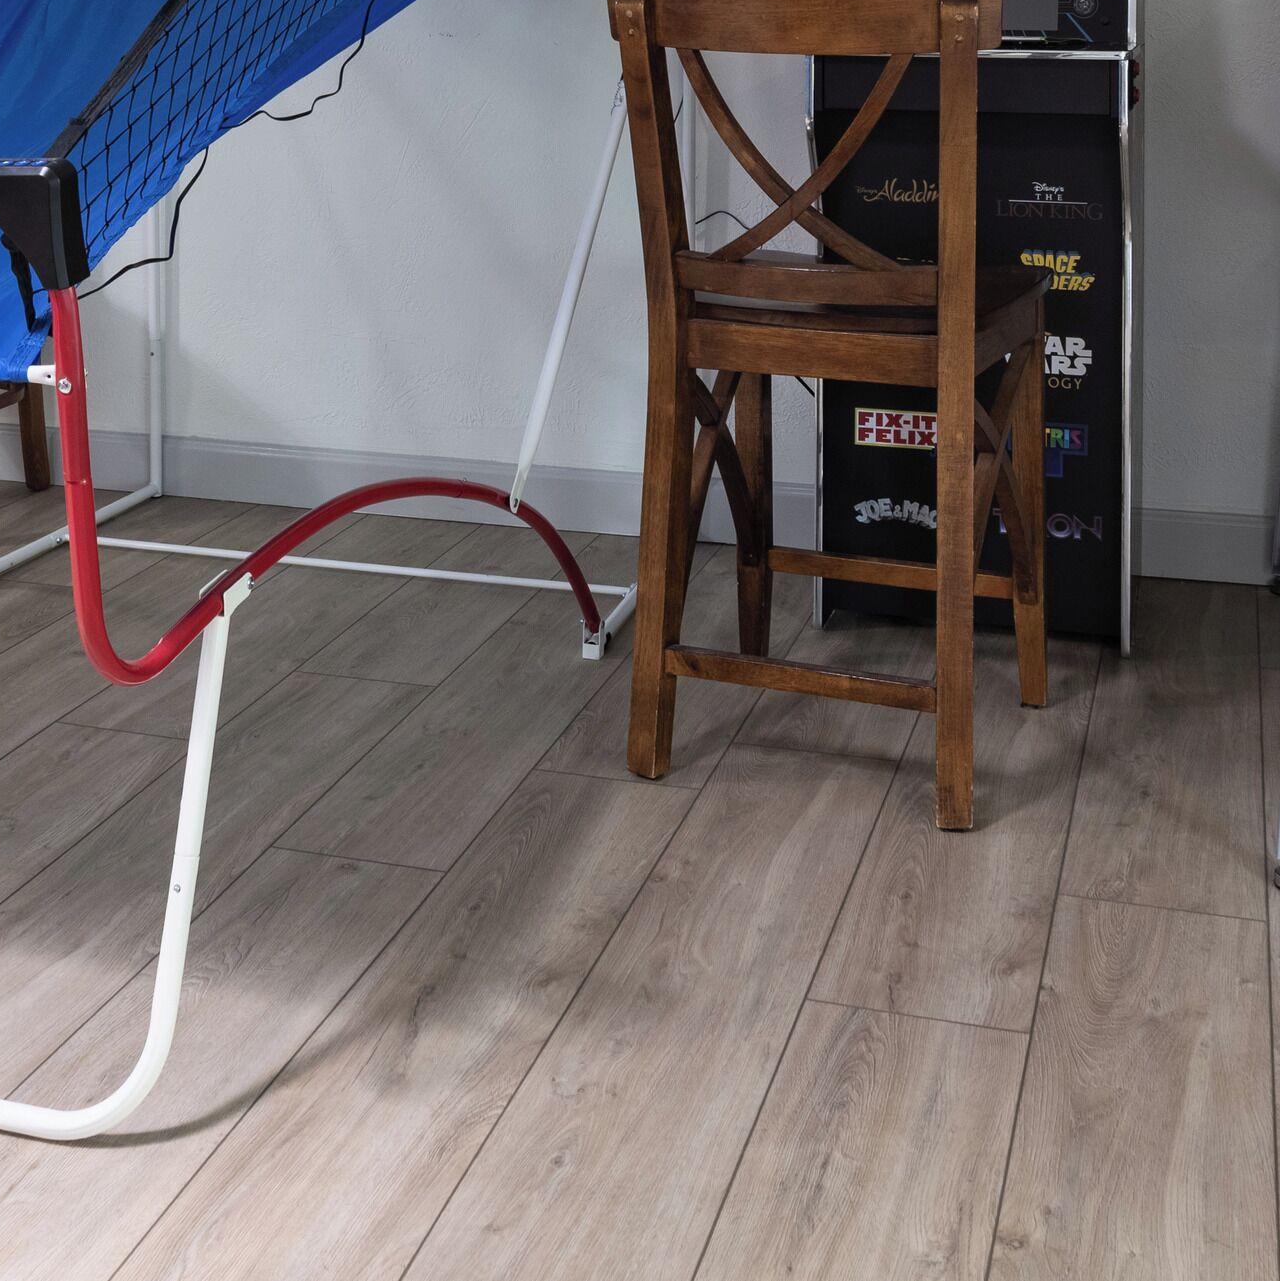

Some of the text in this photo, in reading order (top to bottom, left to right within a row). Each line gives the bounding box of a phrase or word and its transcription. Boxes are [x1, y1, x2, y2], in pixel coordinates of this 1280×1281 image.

[1035, 193, 1063, 201] THE
[995, 200, 1104, 220] LION KING
[858, 412, 937, 429] FIX-IT
[853, 498, 893, 524] JOE
